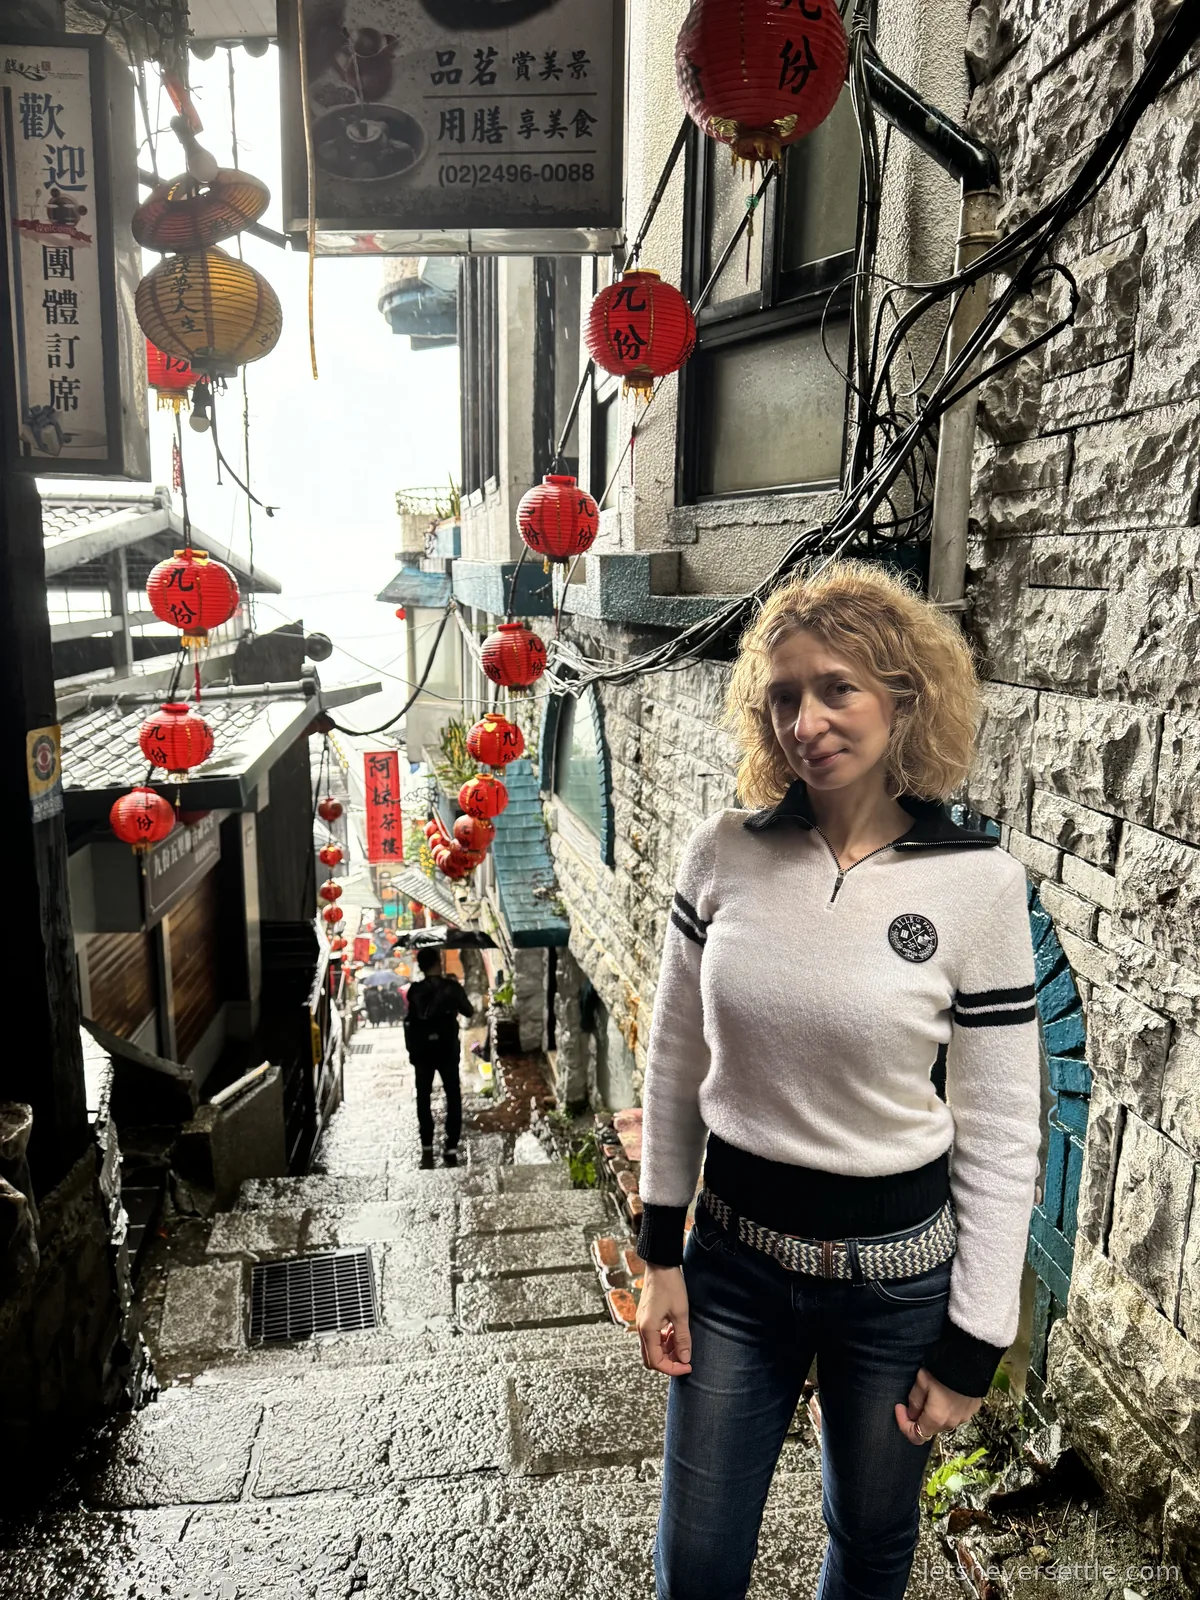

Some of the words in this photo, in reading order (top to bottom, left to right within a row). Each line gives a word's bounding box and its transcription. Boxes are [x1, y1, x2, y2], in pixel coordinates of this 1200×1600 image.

[438, 164, 595, 188] (02)2496-0088
[35, 222, 77, 237] Welcome
[42, 244, 81, 413] 團體訂席
[611, 286, 648, 361] 九份
[577, 498, 595, 548] 九份
[167, 568, 197, 625] 九份
[149, 726, 168, 764] 九份
